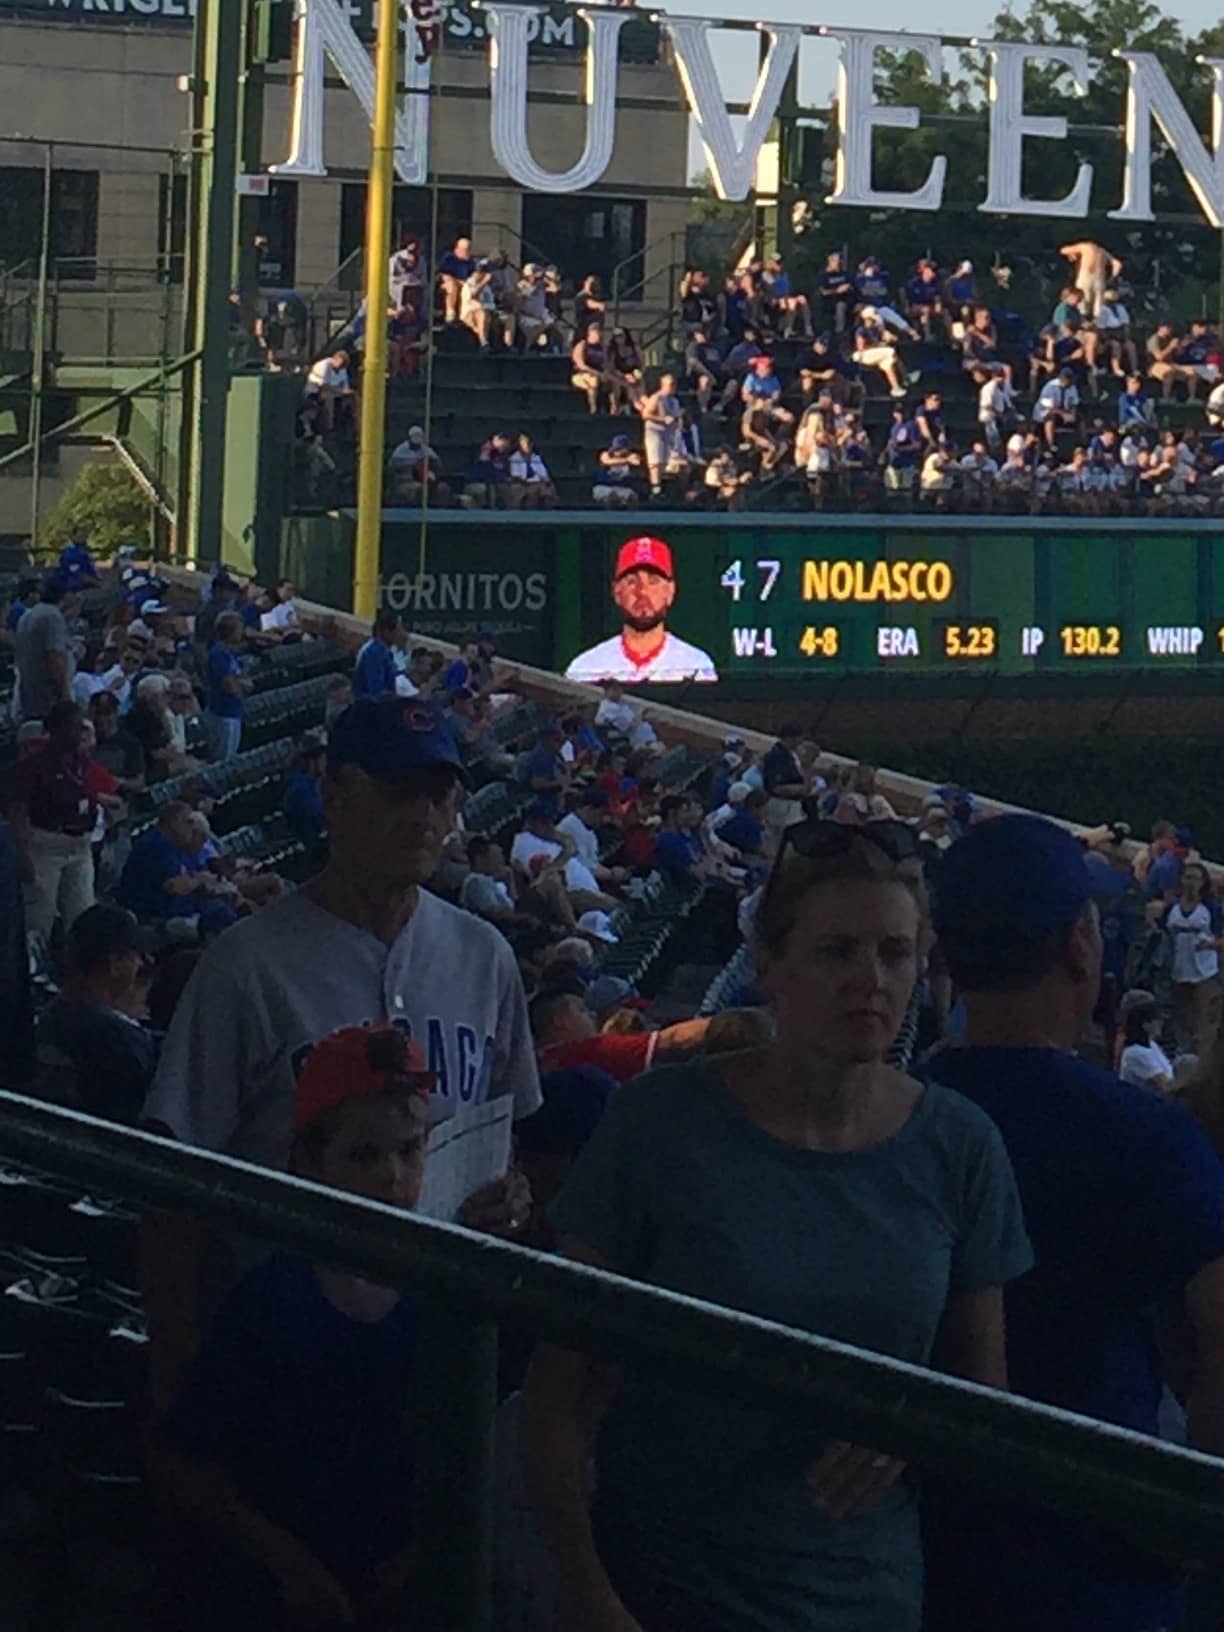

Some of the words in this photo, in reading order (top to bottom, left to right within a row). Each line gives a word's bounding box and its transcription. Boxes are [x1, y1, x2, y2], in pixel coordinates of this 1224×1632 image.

[720, 559, 782, 602] 47
[803, 559, 953, 602] NOLASCO
[732, 627, 778, 657] W-L
[799, 627, 838, 656] 4-8
[877, 627, 919, 656] ERA
[945, 626, 995, 656] 5.23
[1022, 627, 1044, 655] IP
[1061, 626, 1121, 655] 130.2
[1147, 626, 1204, 655] WHIP
